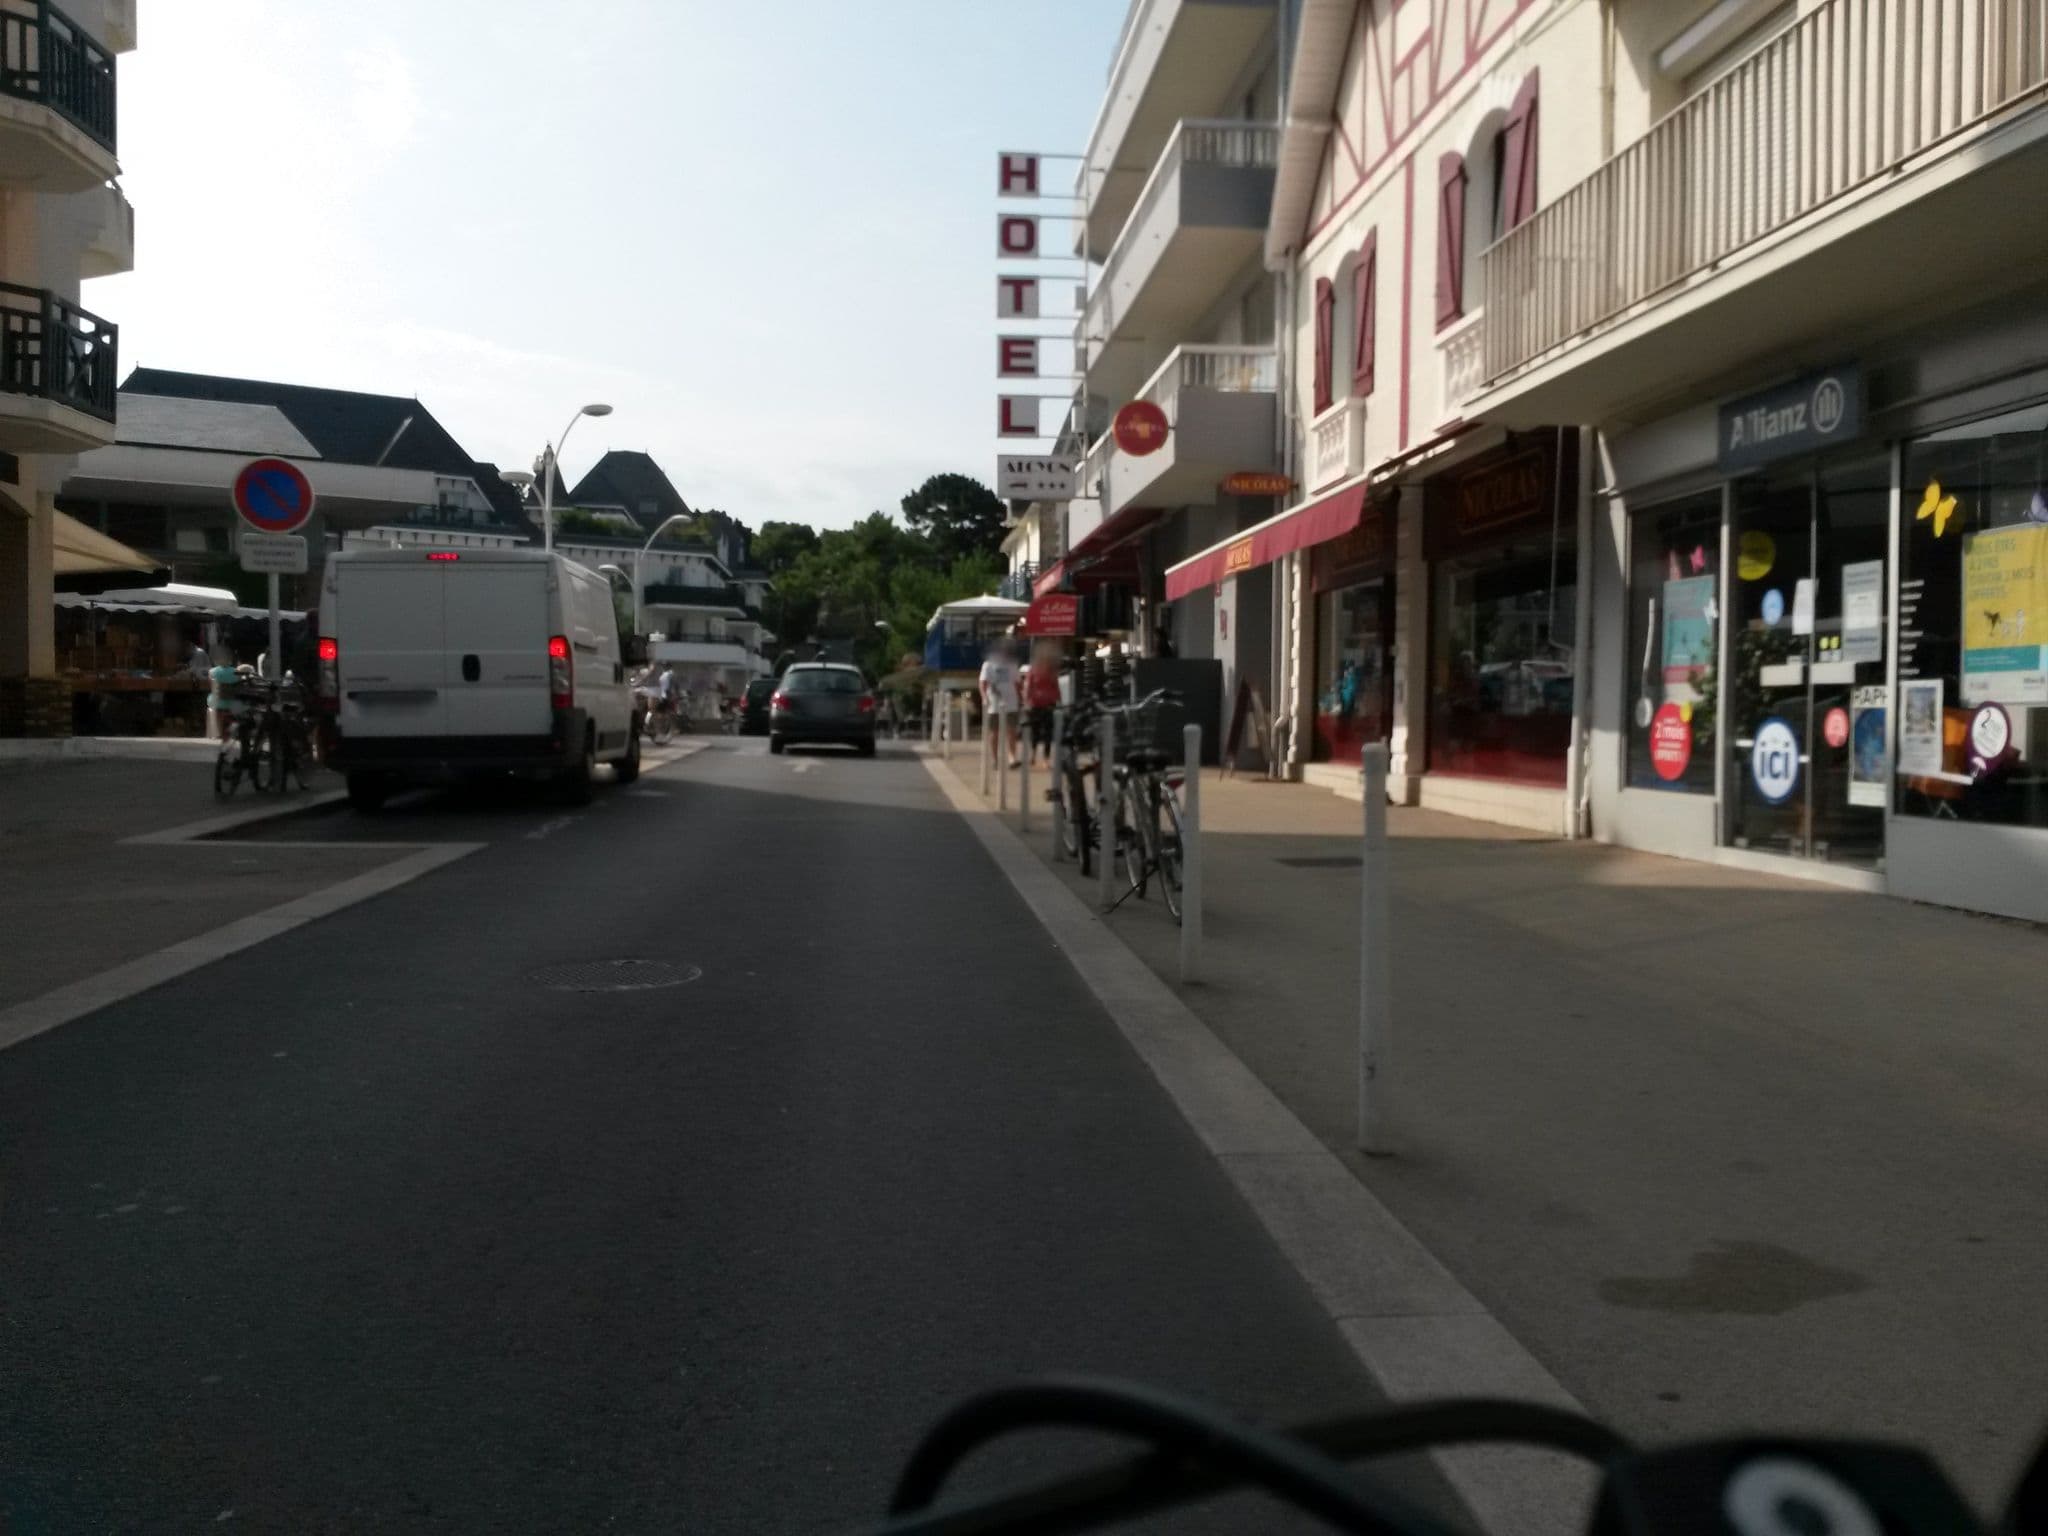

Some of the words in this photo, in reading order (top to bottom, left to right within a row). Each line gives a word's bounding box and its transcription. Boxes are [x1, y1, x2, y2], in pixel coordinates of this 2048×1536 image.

[1001, 155, 1036, 434] HOTEL
[1729, 402, 1808, 451] Allianz
[1230, 478, 1286, 490] NICOLAS
[1759, 740, 1790, 779] ici
